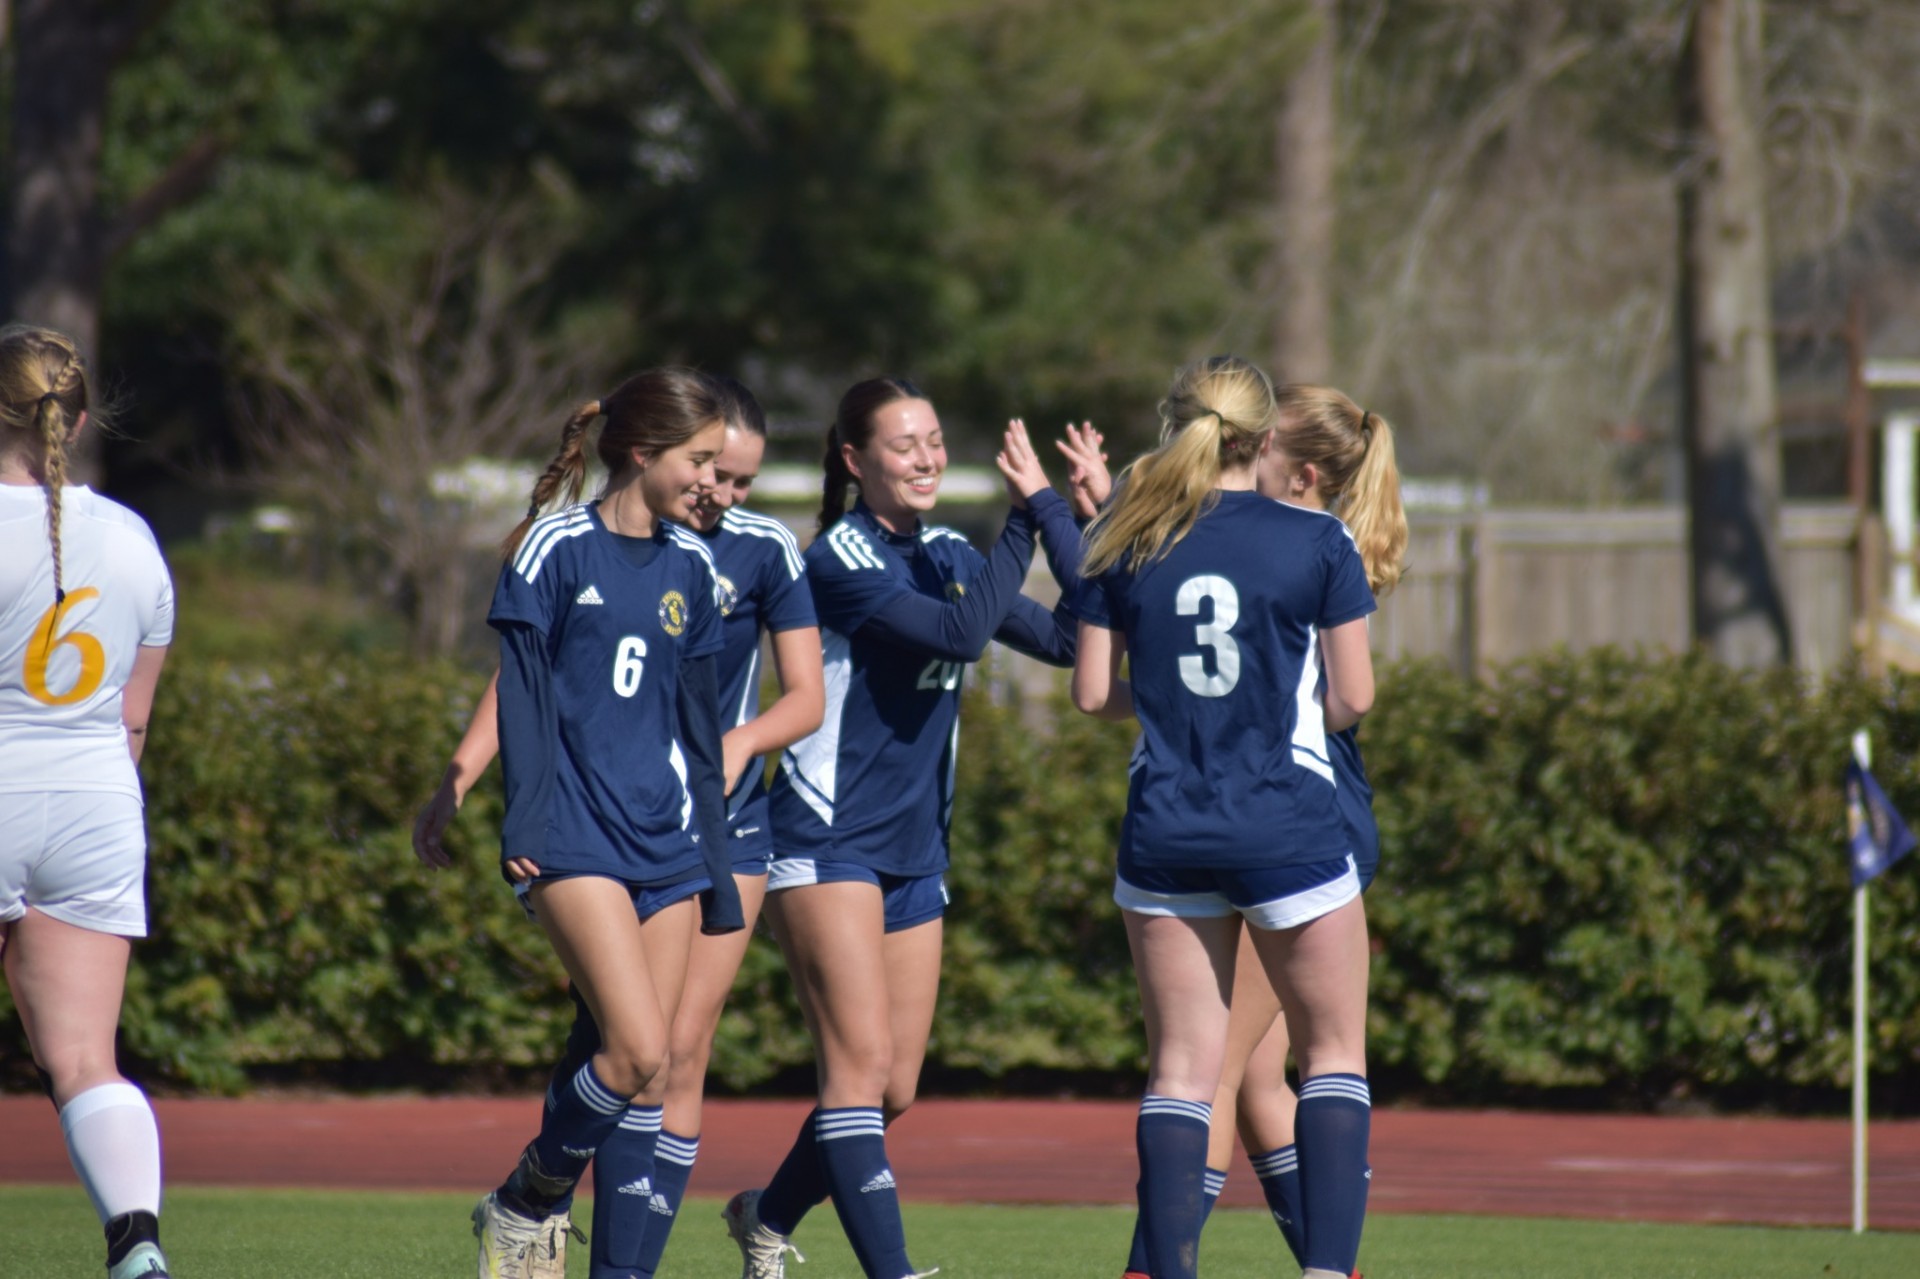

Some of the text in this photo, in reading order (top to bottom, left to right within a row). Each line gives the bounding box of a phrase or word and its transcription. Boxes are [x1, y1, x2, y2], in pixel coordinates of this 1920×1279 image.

[23, 586, 105, 706] 6
[613, 636, 647, 698] 6
[1176, 575, 1240, 697] 3
